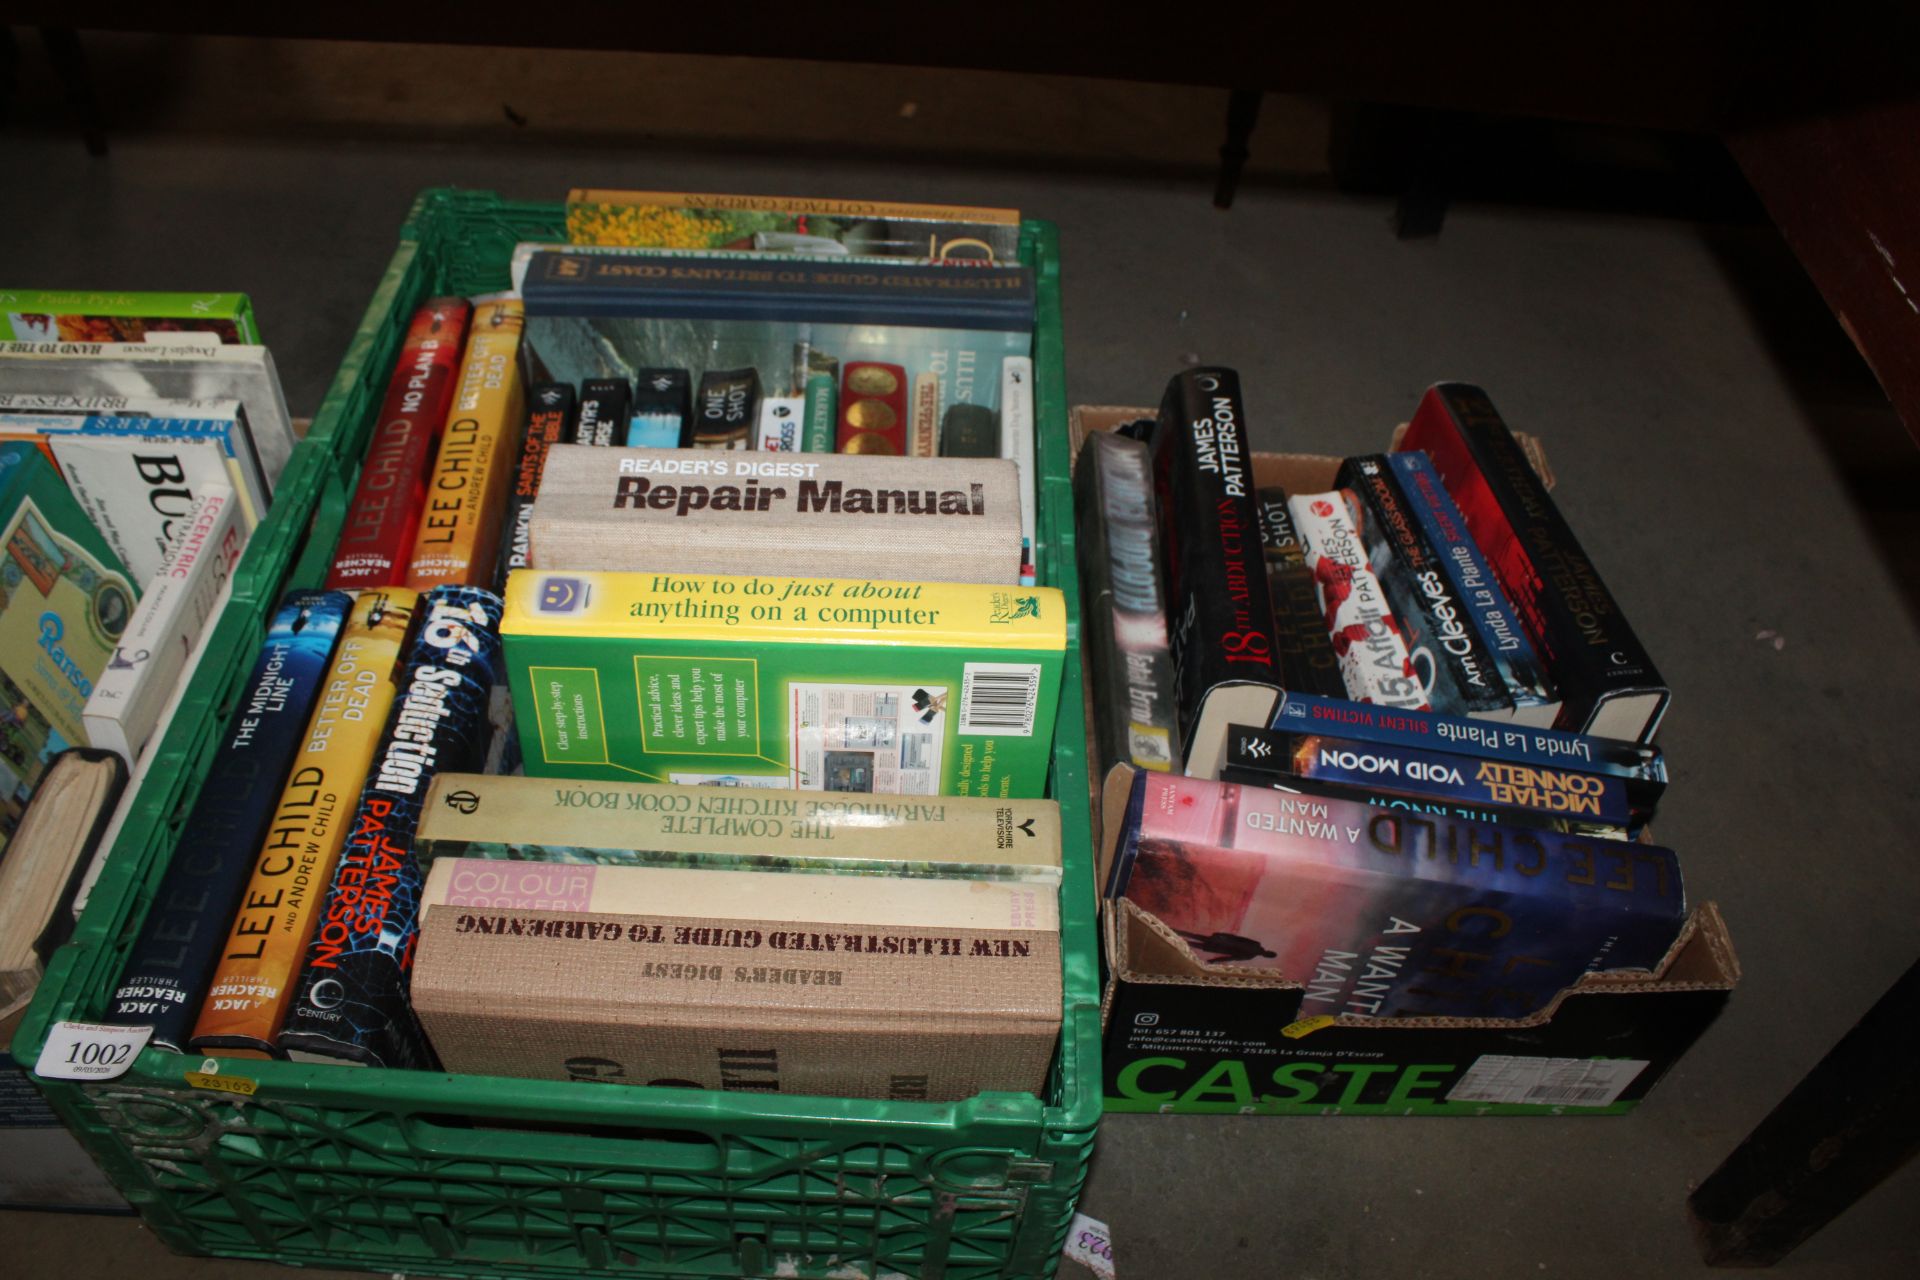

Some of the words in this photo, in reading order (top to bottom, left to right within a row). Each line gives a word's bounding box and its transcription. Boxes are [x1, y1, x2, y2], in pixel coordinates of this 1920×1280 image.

[684, 195, 780, 211] GARDENS
[782, 199, 875, 215] COTTAGE
[597, 262, 666, 277] COAST
[671, 264, 773, 281] BRITAIN'S
[779, 270, 805, 283] TO
[815, 270, 878, 285] GUIDE
[882, 272, 1021, 289] ILLUSTRATED
[10, 342, 36, 353] THE
[39, 343, 57, 353] TO
[61, 343, 103, 355] HAND
[421, 339, 440, 350] B
[473, 336, 496, 362] OFF
[408, 352, 438, 390] PLAN
[484, 354, 507, 391] DEAD
[929, 350, 949, 375] TO
[459, 361, 487, 412] BETTER
[36, 395, 128, 409] BRIDGES
[401, 391, 424, 413] NO
[705, 387, 727, 420] ONE
[726, 383, 747, 423] SHOT
[812, 386, 830, 437] MARKET
[96, 418, 228, 433] MILLER'S
[529, 412, 548, 432] THE
[546, 410, 565, 444] BIBLE
[438, 417, 480, 492] CHILD
[475, 434, 493, 464] CHILD
[524, 432, 543, 453] OF
[1193, 418, 1219, 475] JAMES
[1212, 396, 1247, 498] PATTERSON
[367, 418, 414, 493] CHILD
[619, 458, 729, 476] READER'S
[735, 462, 820, 478] DIGEST
[516, 453, 541, 496] SAINTS
[466, 465, 486, 511] ANDREW
[613, 476, 786, 516] Repair
[797, 479, 985, 516] Manual
[351, 498, 389, 543] LEE
[423, 497, 465, 544] LEE
[1264, 500, 1296, 549] SHOT
[1434, 510, 1462, 543] SILENT
[156, 494, 206, 577] CONTRAPTIONS
[171, 496, 224, 579] ECCENTRIC
[510, 503, 534, 567] RANKIN
[335, 557, 392, 569] REACHER
[340, 566, 372, 577] JACK
[411, 556, 470, 569] REACHER
[416, 566, 448, 577] JACK
[1328, 518, 1375, 603] PATTERSON
[1451, 545, 1486, 589] Plante
[651, 576, 699, 595] How
[712, 577, 735, 594] to
[744, 578, 774, 596] do
[777, 580, 836, 602] just
[843, 581, 922, 600] about
[1475, 588, 1496, 608] La
[1527, 525, 1610, 648] PATTERSON
[630, 599, 740, 626] anything
[751, 603, 782, 621] on
[793, 606, 806, 622] a
[818, 605, 940, 630] computer
[1416, 570, 1473, 657] Cleeves
[1353, 605, 1399, 672] Affair
[1484, 610, 1519, 652] Lynda
[690, 667, 702, 683] you
[710, 672, 723, 686] of
[1460, 650, 1487, 688] Ann
[265, 677, 295, 712] LINE
[646, 673, 662, 702] advice,
[668, 674, 681, 691] and
[690, 684, 704, 704] help
[1028, 672, 1037, 701] 424359
[231, 717, 260, 750] THE
[247, 642, 292, 714] MIDNIGHT
[343, 670, 377, 722] DEAD
[549, 681, 567, 729] step-by-step
[670, 692, 683, 715] ideas
[712, 688, 725, 707] most
[735, 679, 749, 718] computer
[574, 693, 588, 741] instructions
[649, 702, 664, 738] Practical
[692, 704, 706, 721] tips
[712, 707, 726, 721] the
[960, 712, 968, 727] ISBN
[1024, 701, 1034, 729] 780276
[1312, 705, 1374, 726] VICTIMS
[1378, 715, 1429, 734] SILENT
[374, 664, 463, 795] Seduction
[671, 715, 684, 738] clever
[693, 721, 706, 746] expert
[714, 721, 727, 742] make
[737, 719, 750, 739] your
[1436, 722, 1499, 749] Plante
[556, 731, 570, 752] Clear
[984, 739, 995, 756] you
[1504, 732, 1527, 753] La
[1535, 736, 1591, 762] Lynda
[959, 744, 974, 771] designed
[982, 755, 995, 771] help
[1321, 749, 1400, 776] MOON
[1406, 759, 1465, 786] VOID
[1475, 762, 1606, 797] CONNELLY
[227, 888, 285, 961] LEE
[260, 765, 325, 878] CHILD
[307, 681, 349, 754] BETTER
[337, 641, 365, 675] OFF
[554, 790, 619, 809] BOOK
[627, 793, 691, 812] COOK
[697, 796, 799, 818] KITCHEN
[1281, 798, 1329, 820] MAN
[1482, 780, 1602, 816] MICHAEL
[311, 793, 338, 837] CHILD
[806, 800, 946, 822] FARMHOUSE
[661, 815, 783, 839] COMPLETE
[790, 820, 835, 840] THE
[995, 807, 1005, 849] TELEVISION
[1004, 807, 1014, 849] YORKSHIRE
[1246, 811, 1339, 841] WANTED
[1346, 825, 1361, 844] A
[1369, 813, 1549, 878] CHILD
[290, 841, 321, 910] ANDREW
[1563, 843, 1669, 897] LEE
[310, 799, 393, 970] PATTERSON
[354, 836, 406, 935] JAMES
[453, 872, 588, 898] COLOUR
[284, 911, 297, 932] AND
[1024, 891, 1036, 928] PRESS
[455, 914, 623, 941] GARDENING
[628, 924, 666, 943] TO
[675, 926, 762, 949] GUIDE
[1382, 916, 1422, 934] A
[768, 930, 962, 956] ILLUSTRATED
[969, 939, 1031, 957] NEW
[129, 976, 181, 987] THRILLER
[222, 976, 270, 985] THRILLER
[643, 962, 723, 981] DIGEST
[734, 966, 844, 986] READER'S
[1303, 948, 1359, 1003] MAN
[116, 985, 187, 1004] REACHER
[210, 984, 279, 999] REACHER
[117, 1001, 158, 1014] JACK
[161, 1004, 169, 1013] A
[212, 999, 251, 1012] JACK
[1129, 1034, 1267, 1048] info@castellofruits.com
[1132, 1027, 1150, 1036] Tel:
[1155, 1028, 1177, 1037] 657
[1179, 1029, 1202, 1038] 801
[1205, 1030, 1227, 1038] 137
[64, 1042, 132, 1065] 1002
[1243, 1048, 1278, 1056] 25185
[1296, 1050, 1334, 1059] Granja
